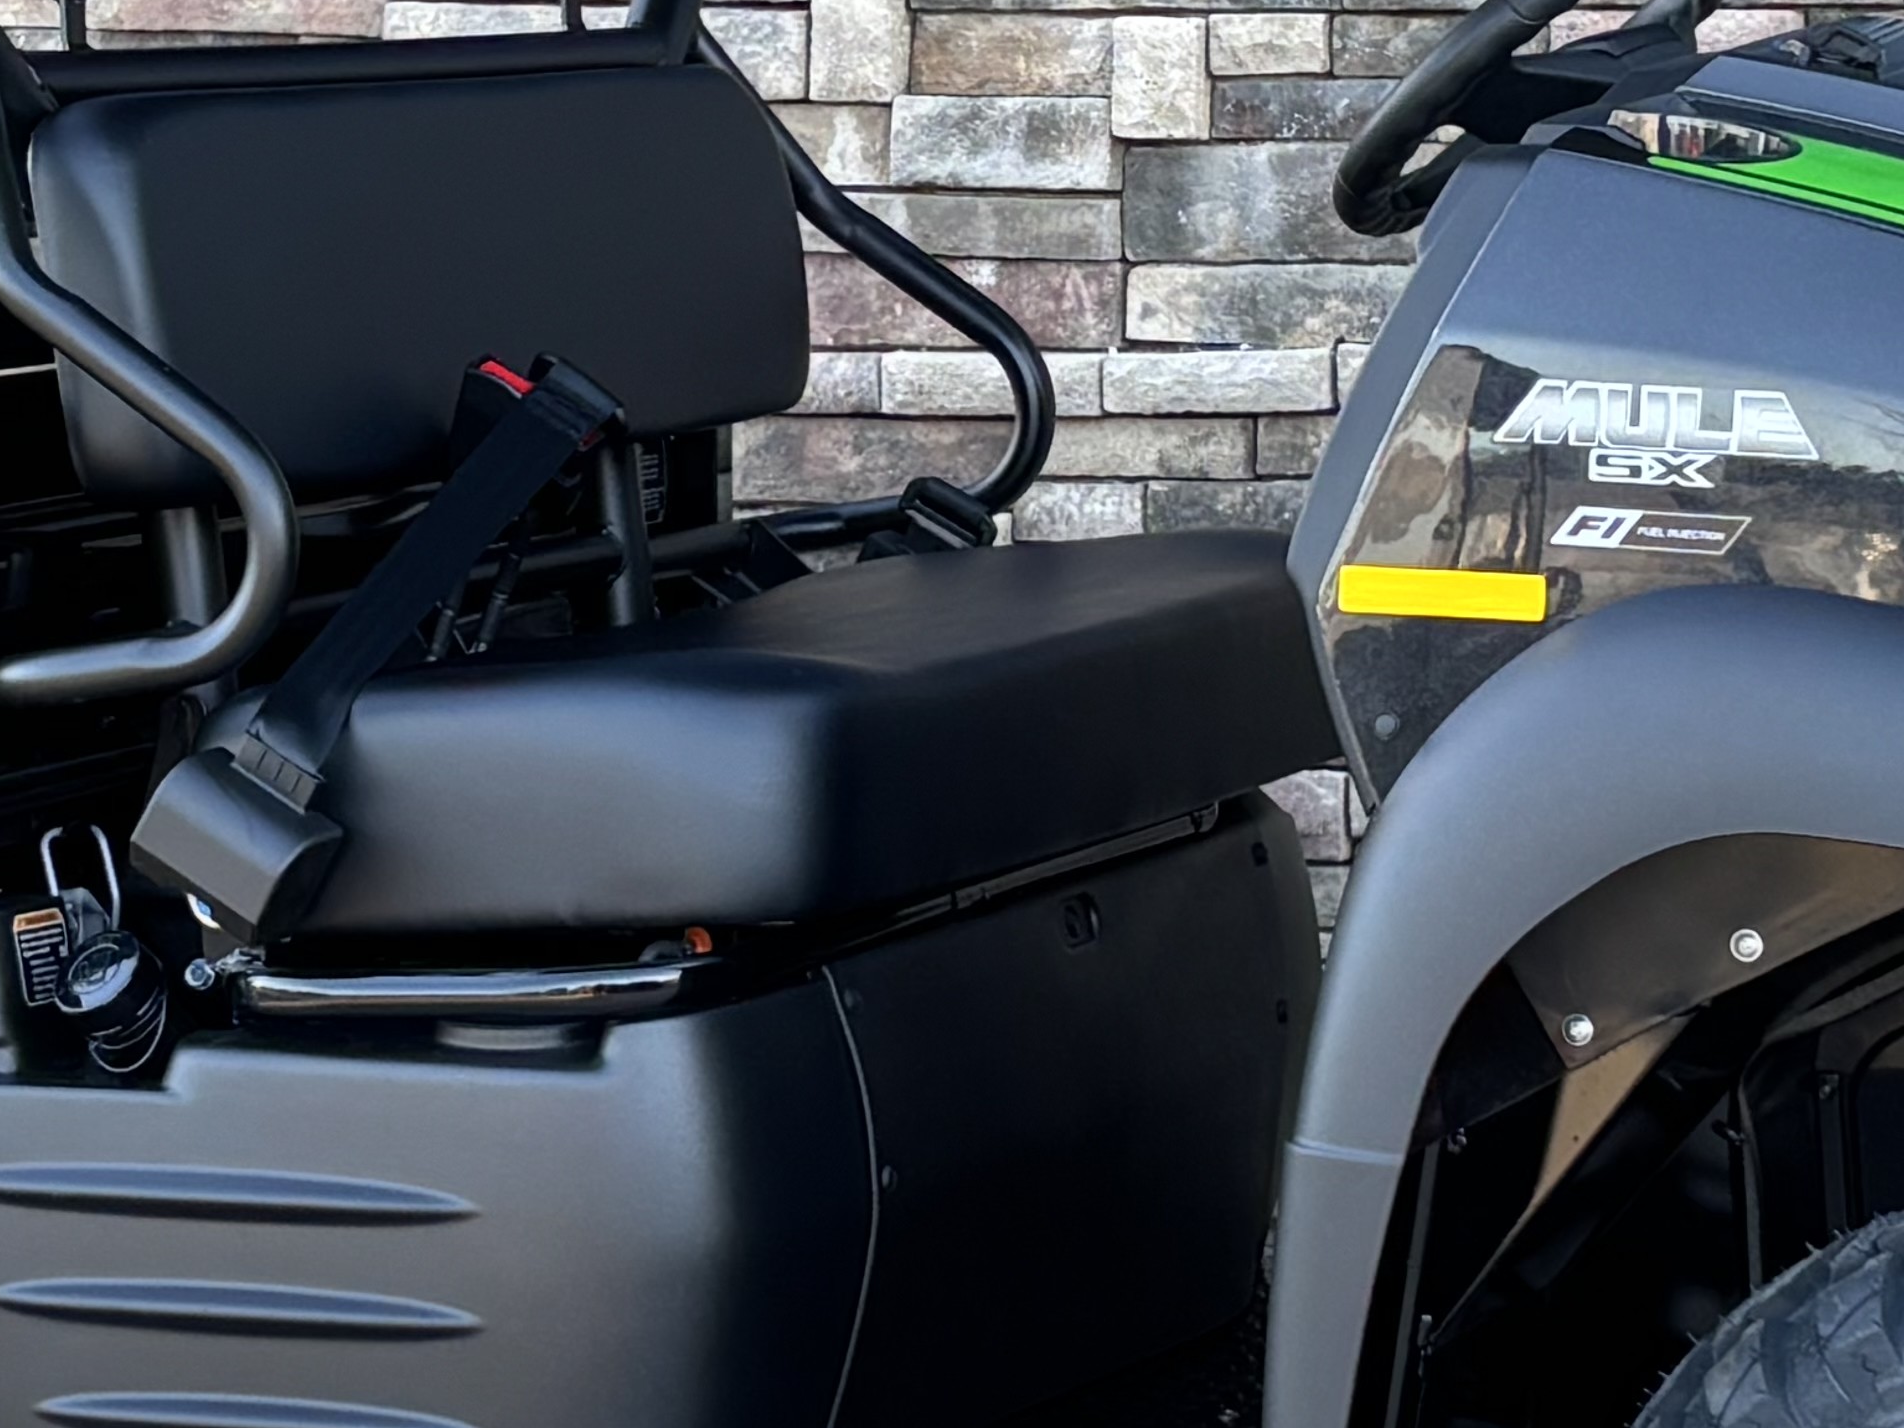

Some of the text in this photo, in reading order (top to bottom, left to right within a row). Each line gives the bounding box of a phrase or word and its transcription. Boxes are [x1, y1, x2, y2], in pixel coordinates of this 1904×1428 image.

[1493, 378, 1819, 460] MULE
[1588, 447, 1718, 488] SX
[1566, 514, 1628, 539] FI
